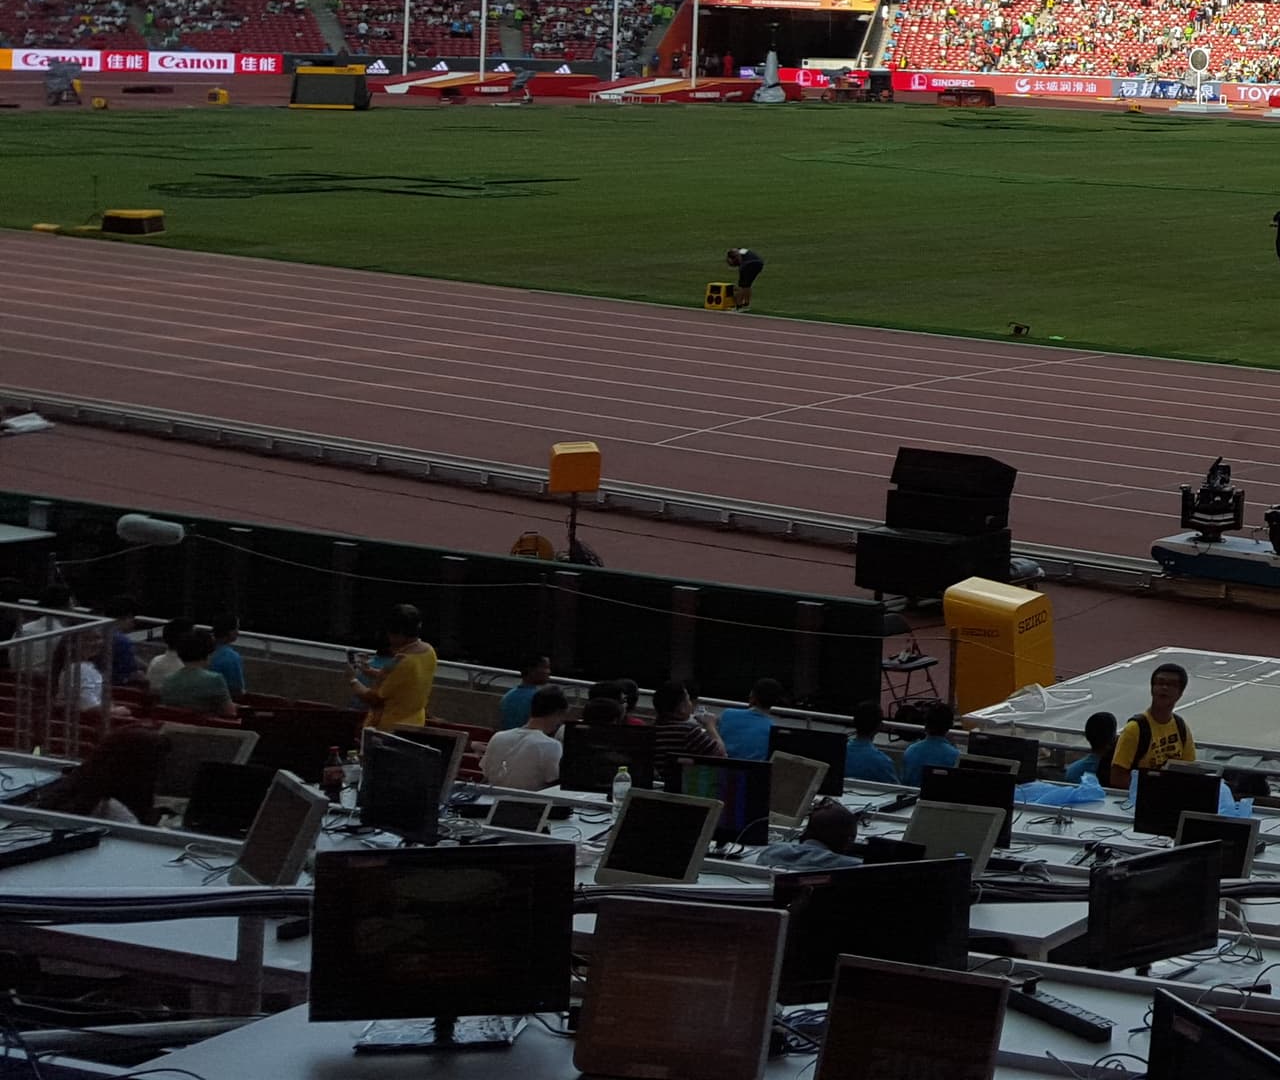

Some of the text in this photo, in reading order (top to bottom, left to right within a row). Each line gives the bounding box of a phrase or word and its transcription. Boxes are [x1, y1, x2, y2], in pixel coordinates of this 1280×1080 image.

[107, 54, 144, 69] 佳能
[158, 55, 228, 70] Canon
[241, 56, 276, 71] 佳能
[931, 78, 975, 87] SINOPEC
[1018, 609, 1048, 634] SEIKO
